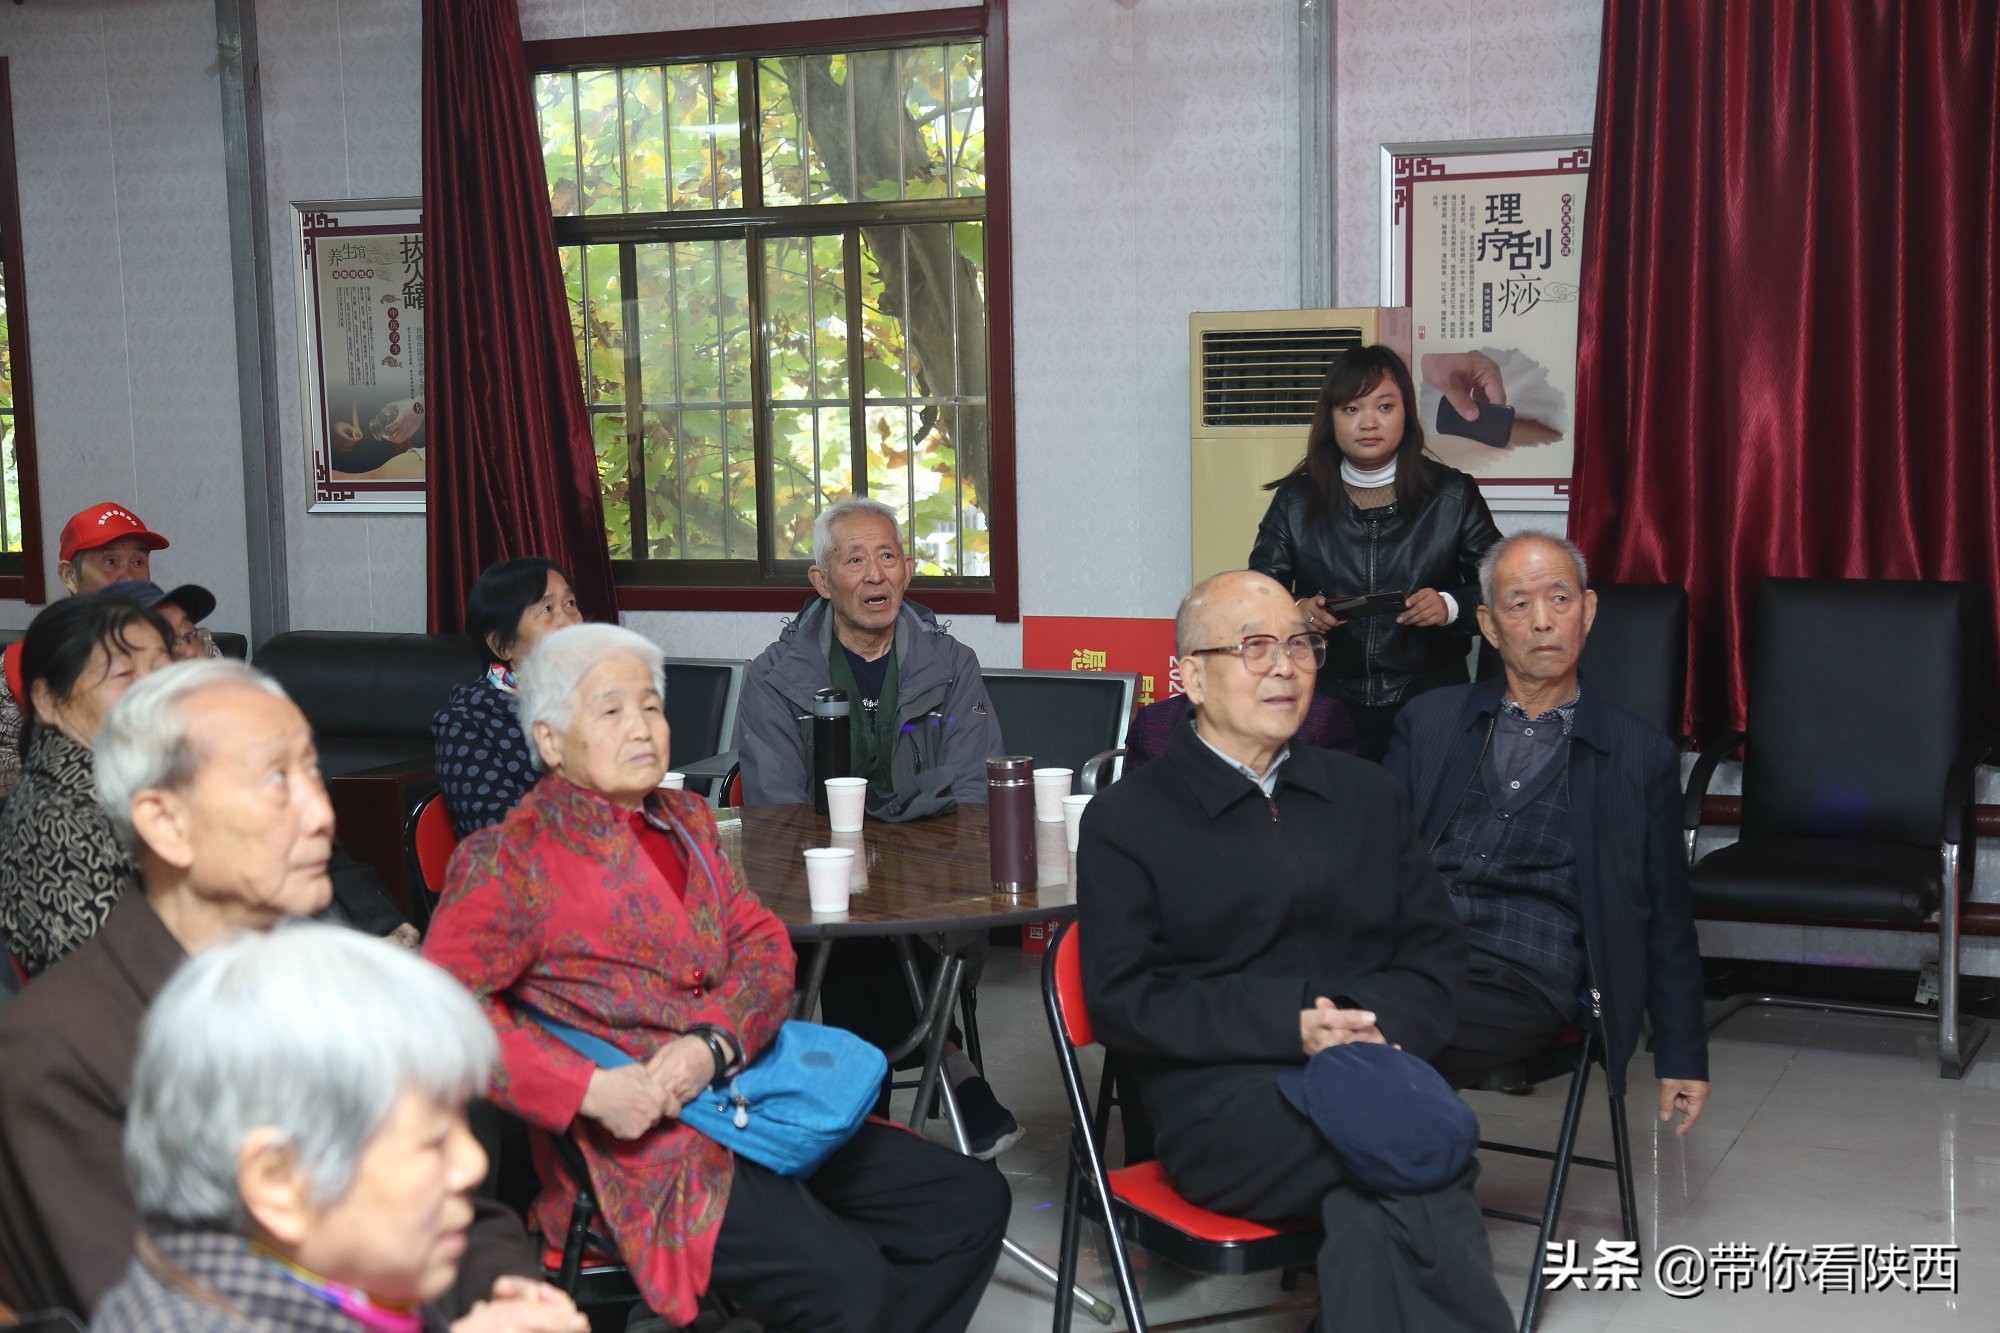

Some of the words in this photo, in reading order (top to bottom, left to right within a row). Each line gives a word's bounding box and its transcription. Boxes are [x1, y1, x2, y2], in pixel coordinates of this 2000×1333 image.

[328, 243, 366, 267] 养生馆
[388, 307, 401, 355] 中医养生
[1168, 655, 1188, 699] 202
